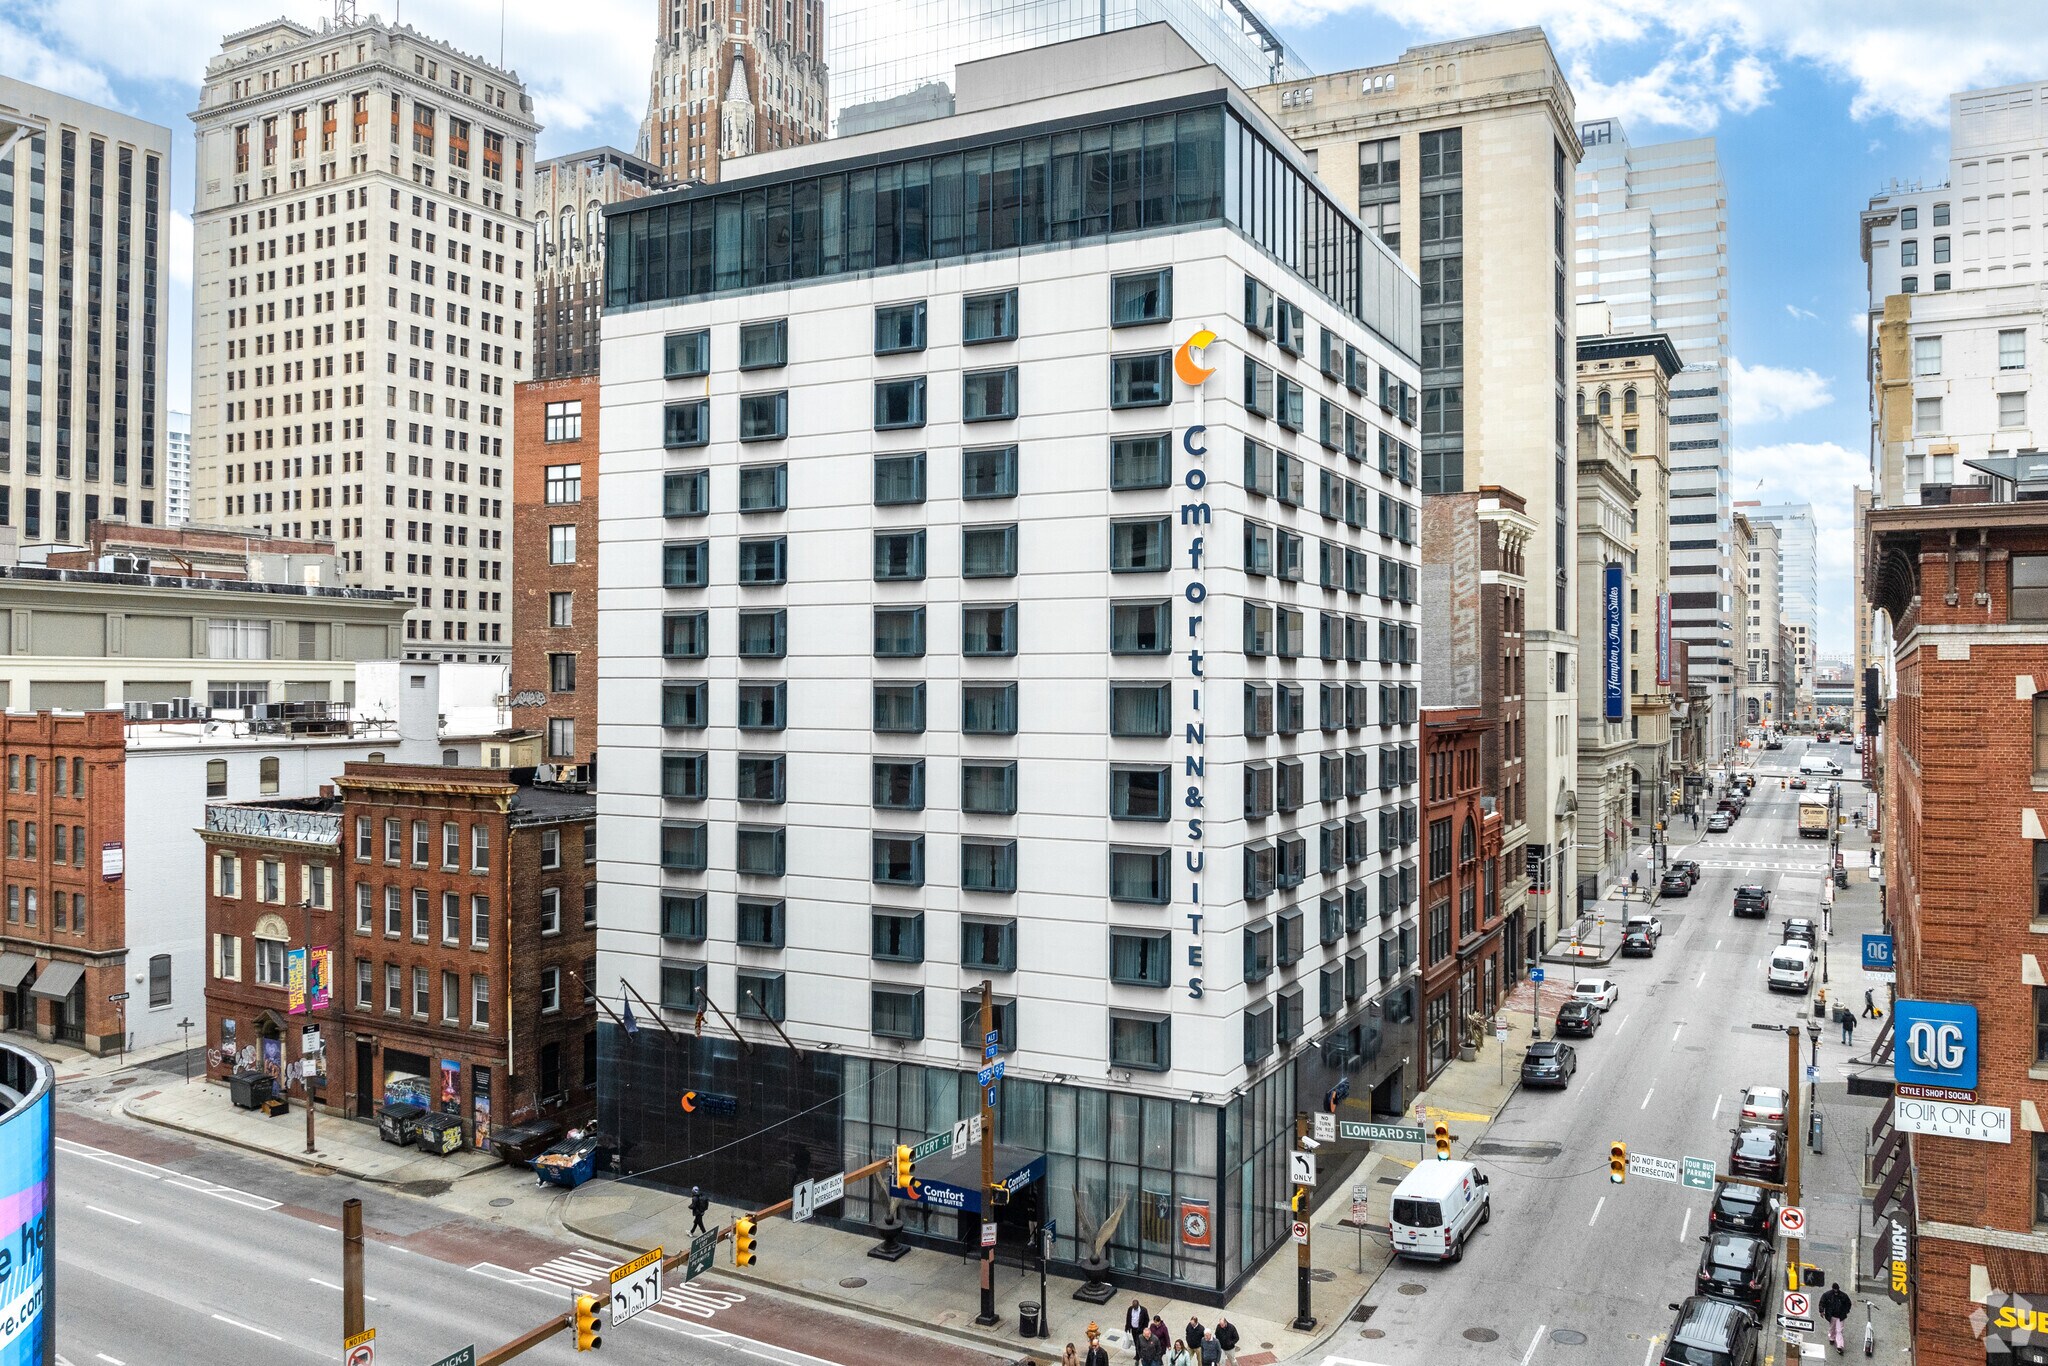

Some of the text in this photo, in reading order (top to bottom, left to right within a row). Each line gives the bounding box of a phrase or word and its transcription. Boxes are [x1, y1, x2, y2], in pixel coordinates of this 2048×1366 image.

[1180, 424, 1212, 677] Comfort
[1453, 501, 1476, 662] CHOCOLATE
[1607, 586, 1620, 614] Suites
[1608, 620, 1621, 645] Inn
[1607, 646, 1621, 697] Hampton
[1185, 689, 1205, 777] INN
[1185, 818, 1205, 1000] SUITES
[1867, 942, 1888, 960] QG
[289, 955, 297, 1010] WELCOME TO
[296, 958, 305, 1005] BALTIMORE
[988, 1033, 996, 1042] ALT
[1906, 1021, 1966, 1070] QG
[979, 1069, 991, 1083] 395
[995, 1064, 1003, 1076] 95
[1900, 1086, 1973, 1101] STYLE SHOP SOCIAL
[1899, 1101, 2006, 1130] FOUR ONE OH
[1346, 1125, 1422, 1140] LOMBARD ST.
[1915, 1121, 1988, 1138] SALON
[911, 1140, 940, 1160] LVERT
[942, 1134, 951, 1146] ST
[953, 1142, 966, 1153] ONLY
[1631, 1155, 1677, 1170] DO NOT BLOCK
[1684, 1160, 1714, 1171] TOUR BUS
[1007, 1168, 1031, 1189] Comfort
[1293, 1173, 1313, 1183] ONLY
[1632, 1165, 1675, 1180] INTERSECTION
[1686, 1168, 1712, 1179] PARKING
[814, 1177, 843, 1195] DO NOT BLOCK
[923, 1185, 965, 1203] Comfort
[815, 1187, 842, 1205] INTERSECTION
[927, 1195, 938, 1203] INN
[944, 1199, 963, 1208] SUITES
[795, 1207, 811, 1220] ONLY
[614, 1251, 658, 1281] NEXT SIGNAL
[1890, 1218, 1909, 1296] SUBWAY
[529, 1247, 626, 1288] ONLY
[631, 1301, 646, 1314] ONLY
[660, 1281, 748, 1319] BUS
[614, 1309, 628, 1323] ONLY
[1785, 1319, 1797, 1327] ONE
[1993, 1305, 2048, 1335] SUB
[348, 1330, 372, 1348] NOTICE
[439, 1350, 469, 1366] UCKS
